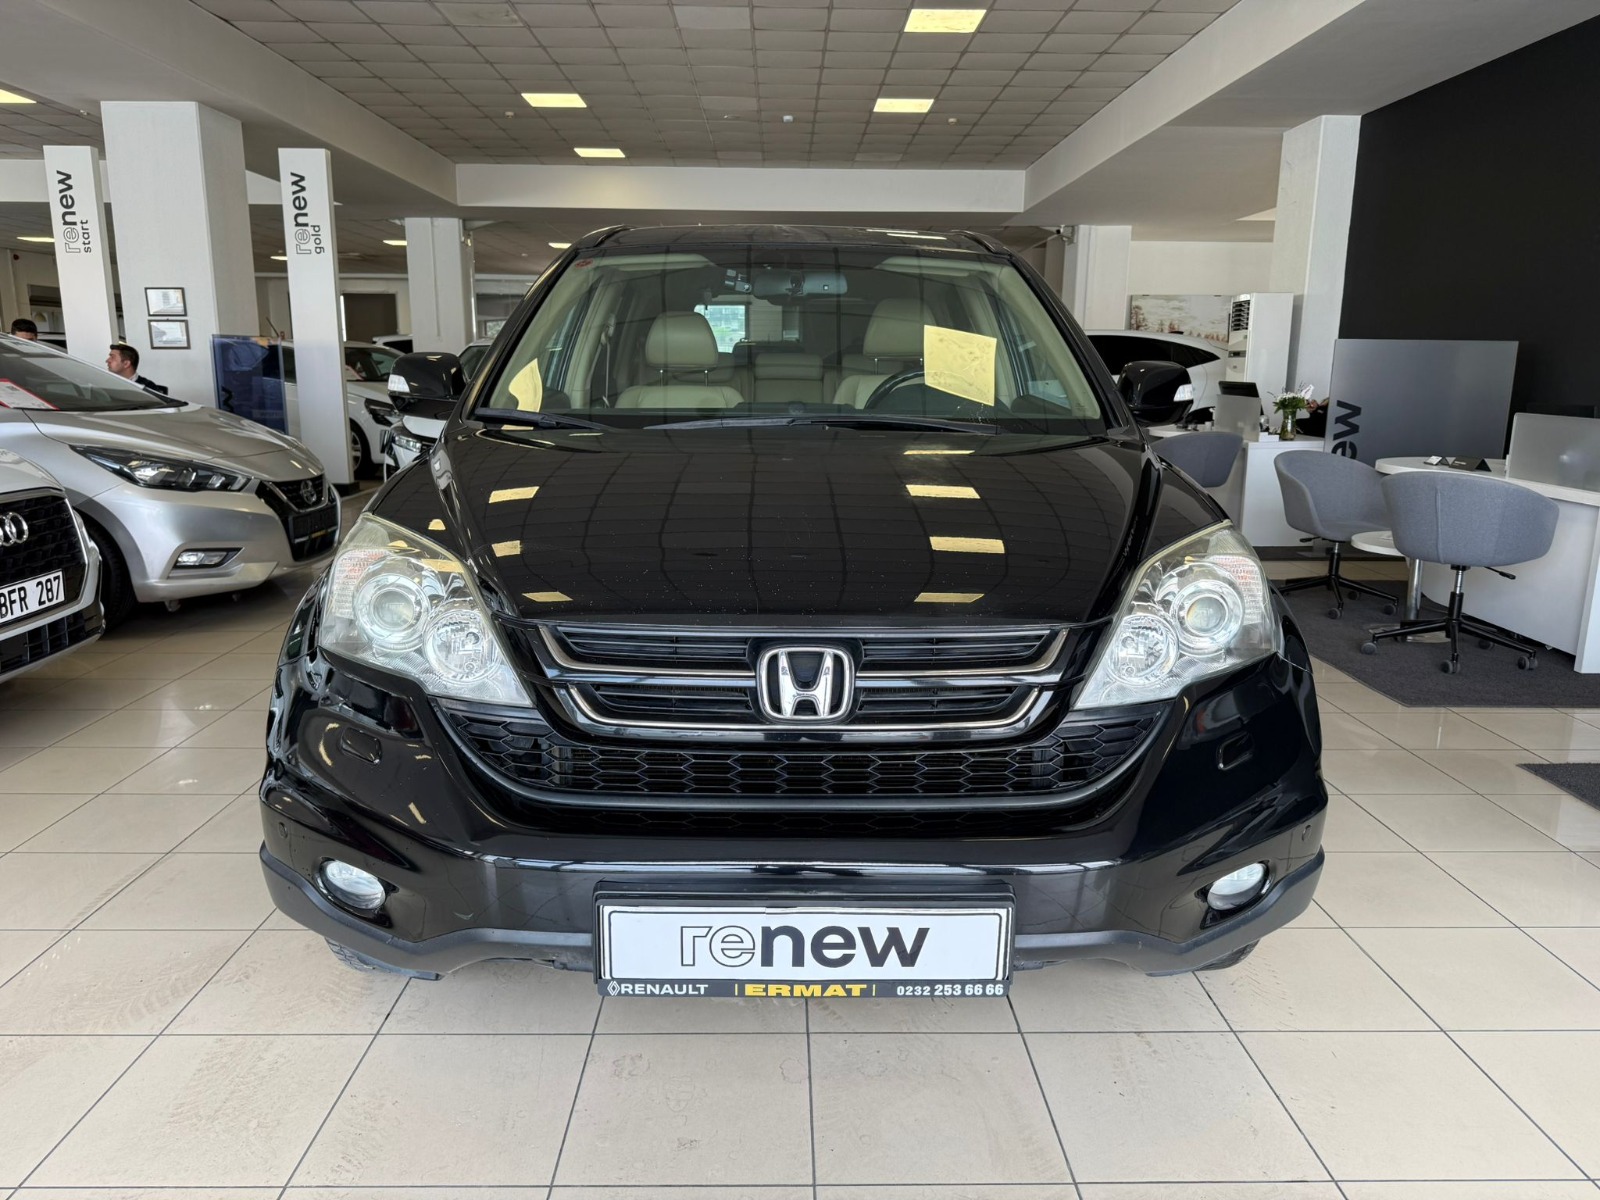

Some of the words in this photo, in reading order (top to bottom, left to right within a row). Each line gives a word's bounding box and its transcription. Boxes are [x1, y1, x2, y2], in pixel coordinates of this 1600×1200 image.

[56, 170, 81, 254] renew
[290, 172, 311, 255] renew
[81, 219, 92, 253] start
[310, 224, 325, 255] gold
[36, 575, 61, 607] 287
[680, 925, 930, 968] renew
[621, 984, 709, 995] RENAULT
[744, 984, 868, 997] ERMAT
[896, 986, 932, 996] 0232
[934, 985, 963, 996] 253
[964, 984, 983, 996] 66
[985, 984, 1004, 996] 66
